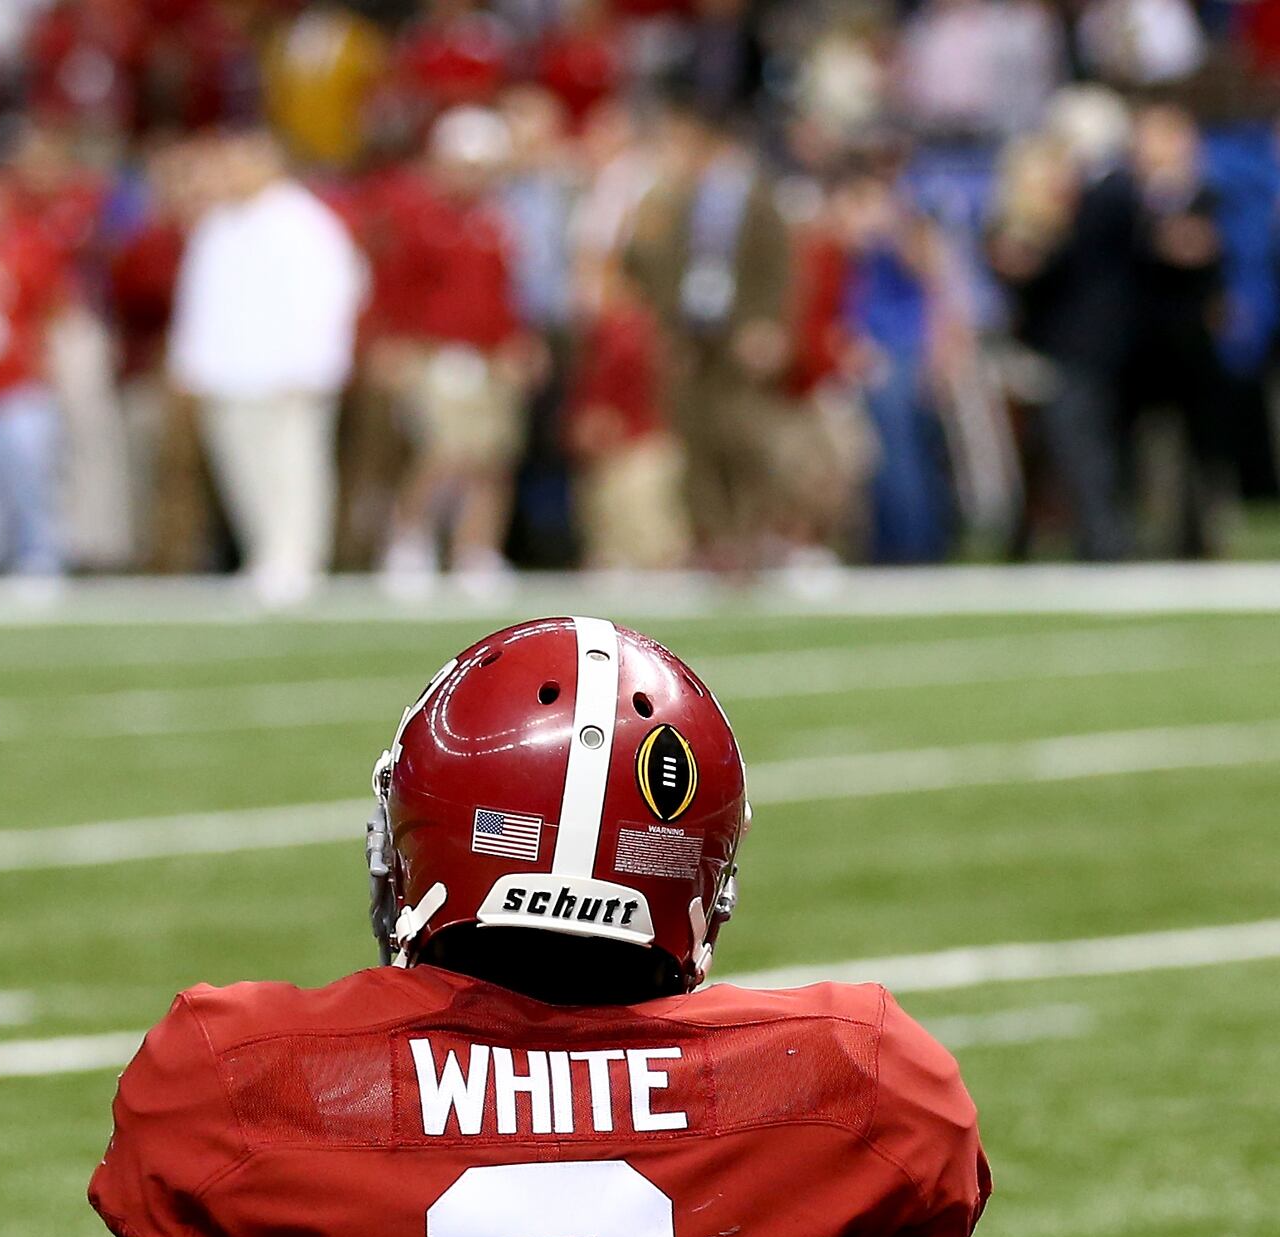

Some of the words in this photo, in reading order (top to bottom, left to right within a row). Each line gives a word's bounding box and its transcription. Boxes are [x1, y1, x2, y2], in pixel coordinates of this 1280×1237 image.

[648, 825, 685, 836] WARNING
[503, 887, 638, 925] schutt
[408, 1037, 688, 1136] WHITE
